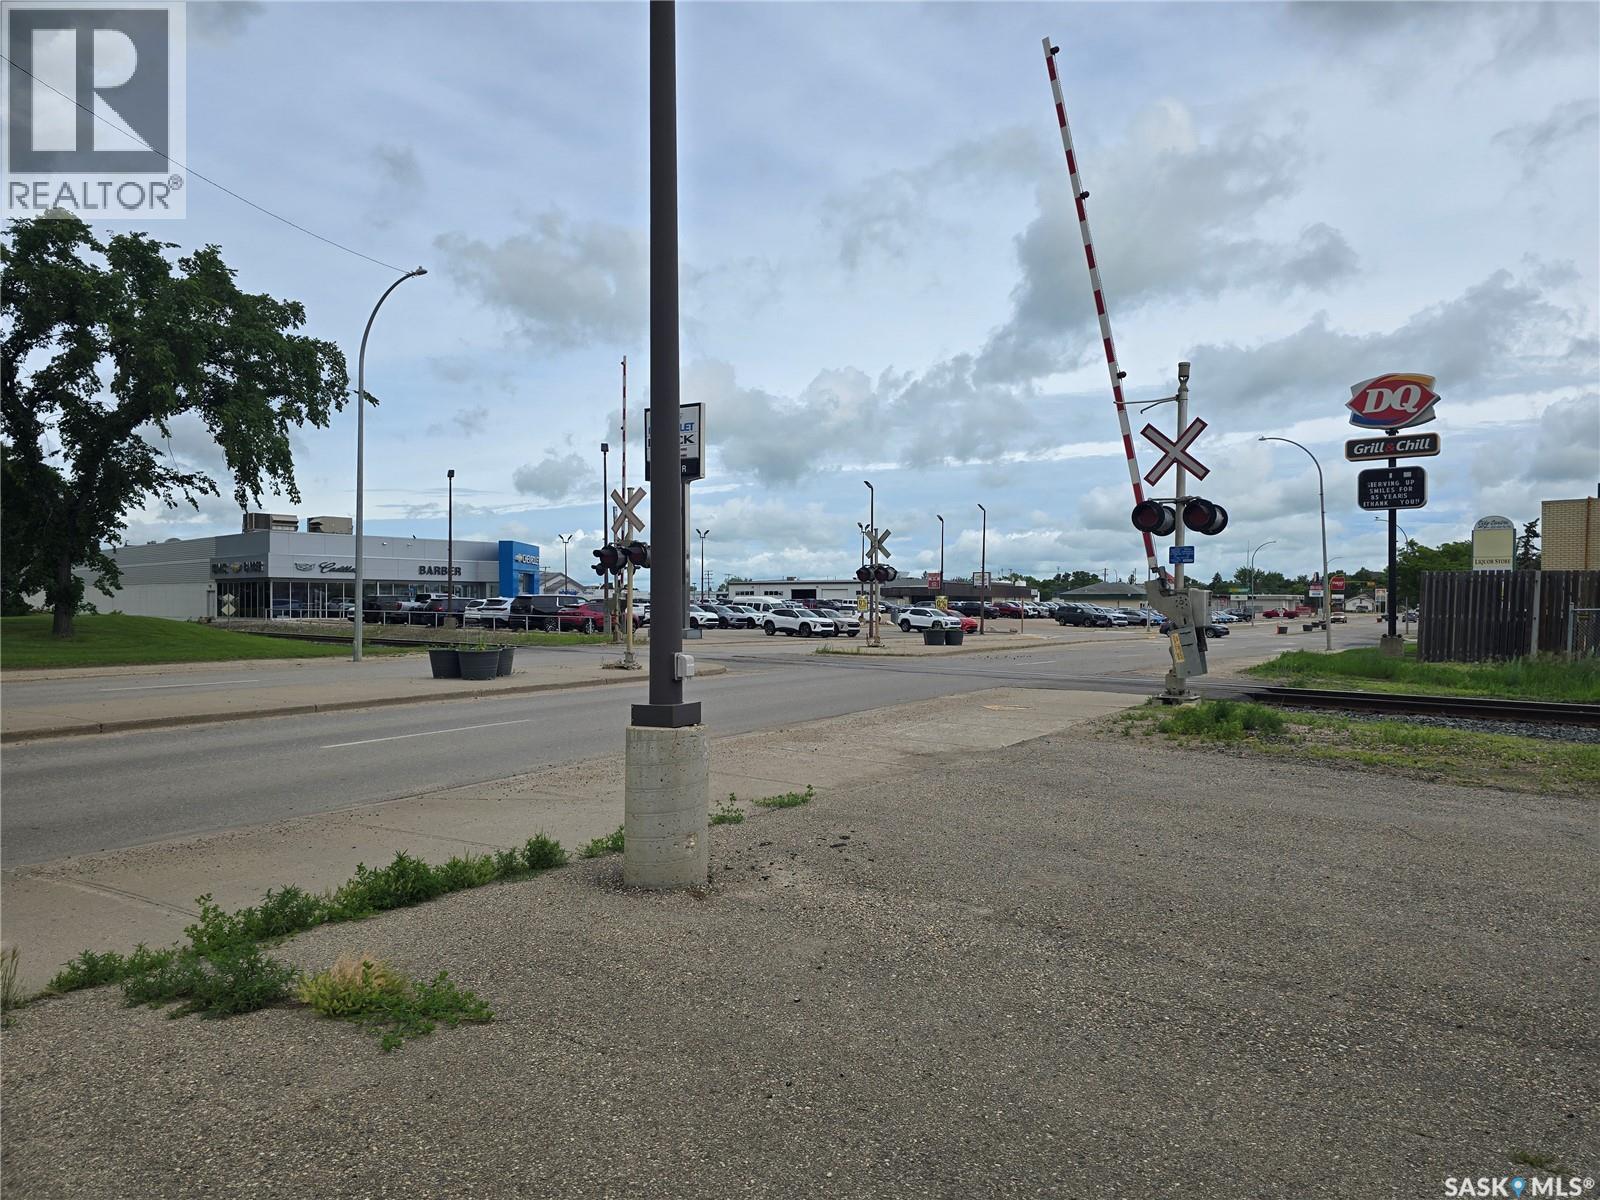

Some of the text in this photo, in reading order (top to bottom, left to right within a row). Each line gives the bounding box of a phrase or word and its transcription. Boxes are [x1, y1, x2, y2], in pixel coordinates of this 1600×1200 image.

[1362, 384, 1421, 414] DQ
[1354, 442, 1384, 455] Grill
[1396, 438, 1430, 451] Chill
[1369, 485, 1413, 494] SMILES FOR
[1383, 492, 1408, 500] YEARS
[418, 565, 461, 576] BARBER
